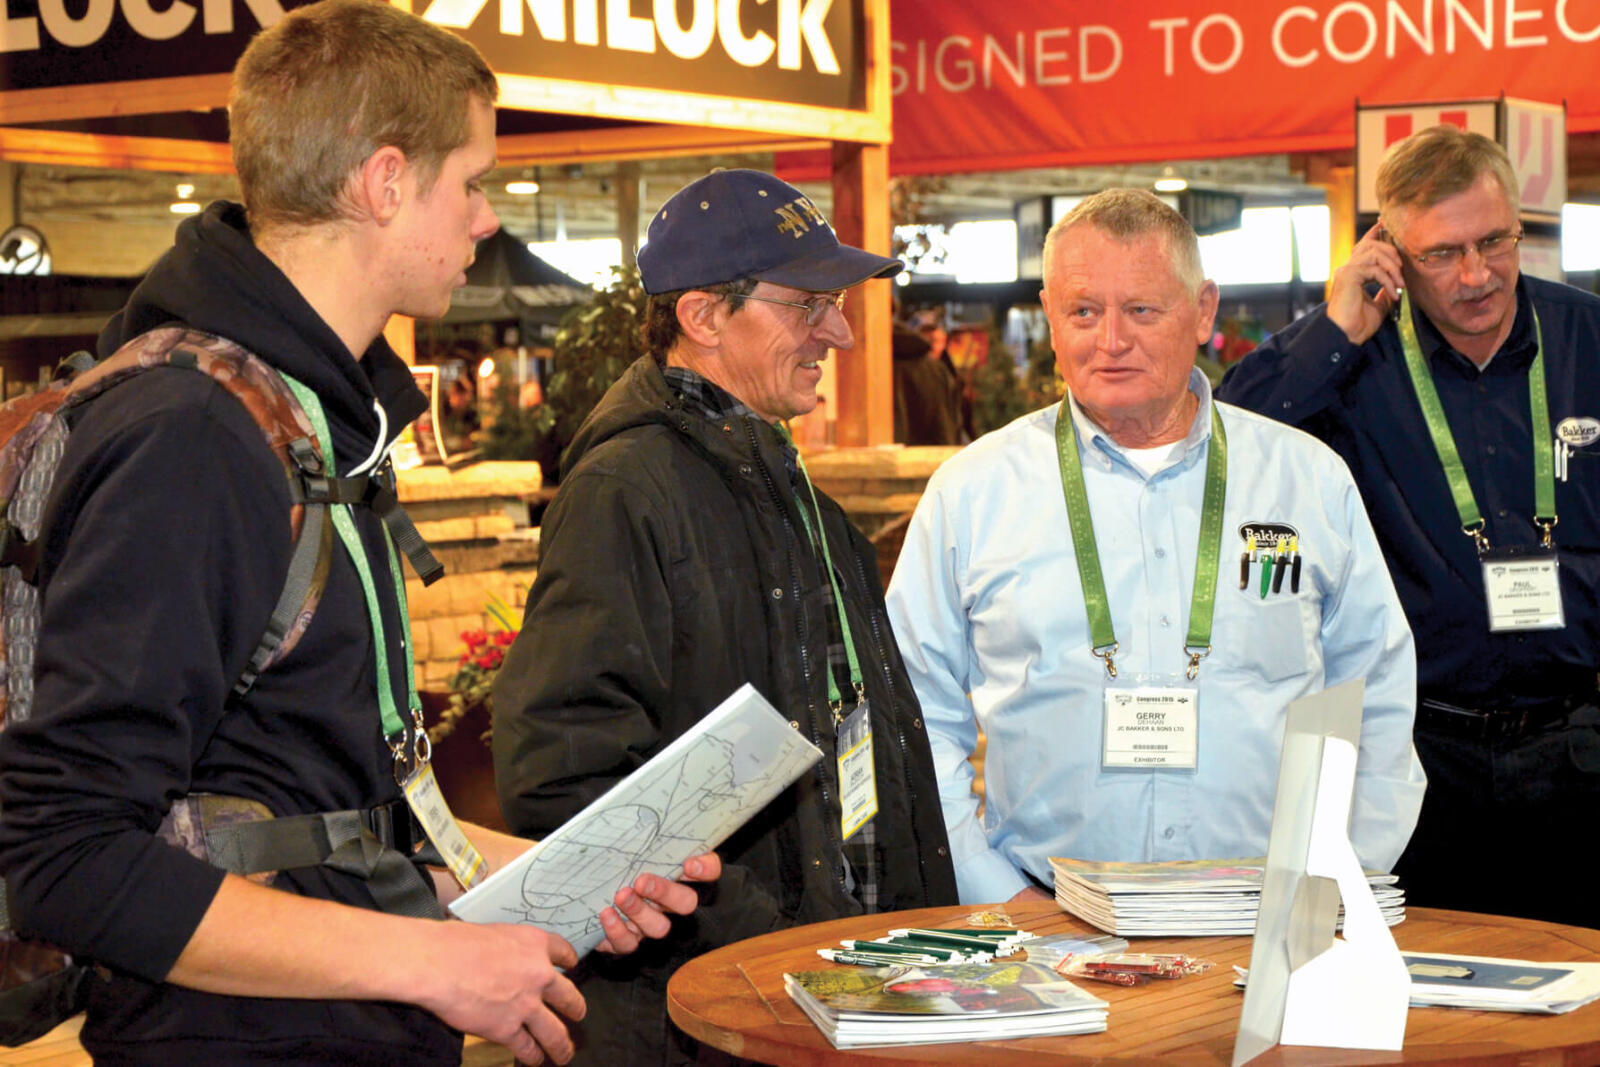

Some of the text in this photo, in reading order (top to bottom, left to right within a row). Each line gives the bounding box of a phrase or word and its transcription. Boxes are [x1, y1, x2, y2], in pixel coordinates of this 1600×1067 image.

[1149, 13, 1245, 76] TO
[1561, 425, 1598, 436] Bakker
[1136, 696, 1161, 704] Congress
[1136, 712, 1166, 720] GERRY
